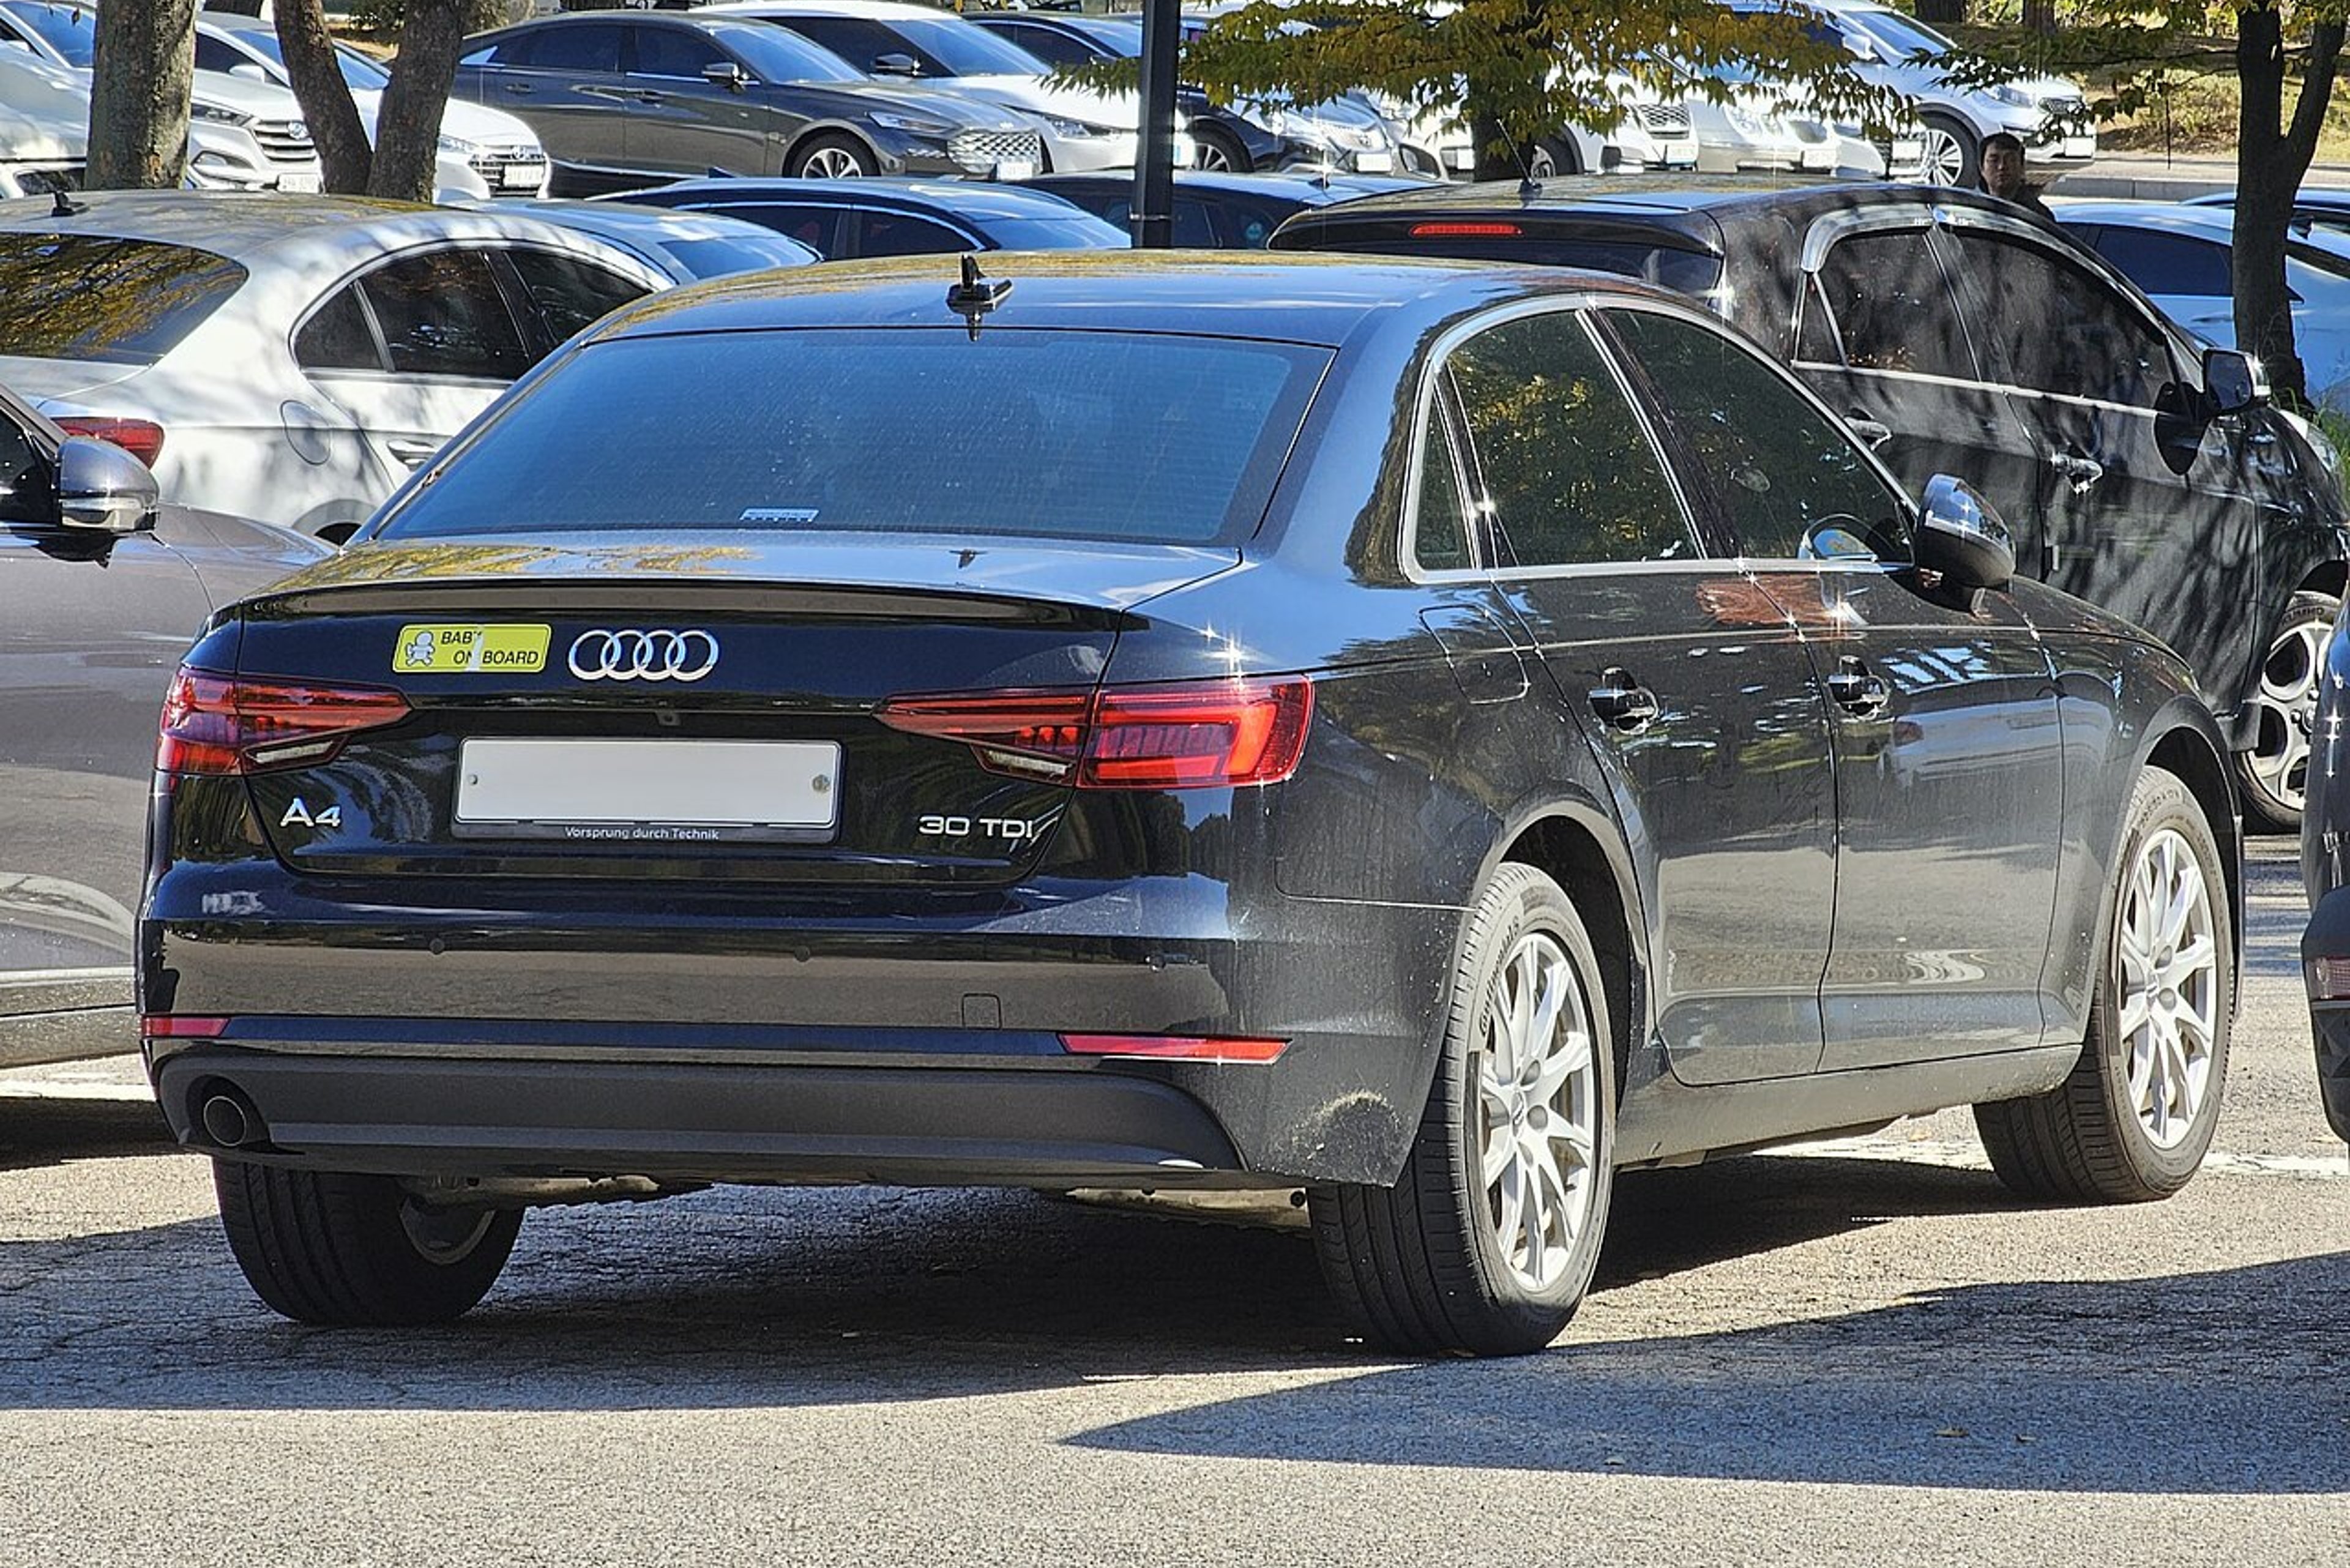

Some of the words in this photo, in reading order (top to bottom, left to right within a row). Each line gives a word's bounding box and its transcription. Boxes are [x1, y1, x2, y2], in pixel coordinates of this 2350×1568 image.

[482, 650, 539, 665] BOARD
[280, 797, 341, 827] A4
[565, 826, 630, 840] Vorsprung
[633, 827, 669, 839] durch
[673, 827, 720, 840] Technik
[919, 815, 970, 836] 30
[979, 818, 1033, 838] TDI
